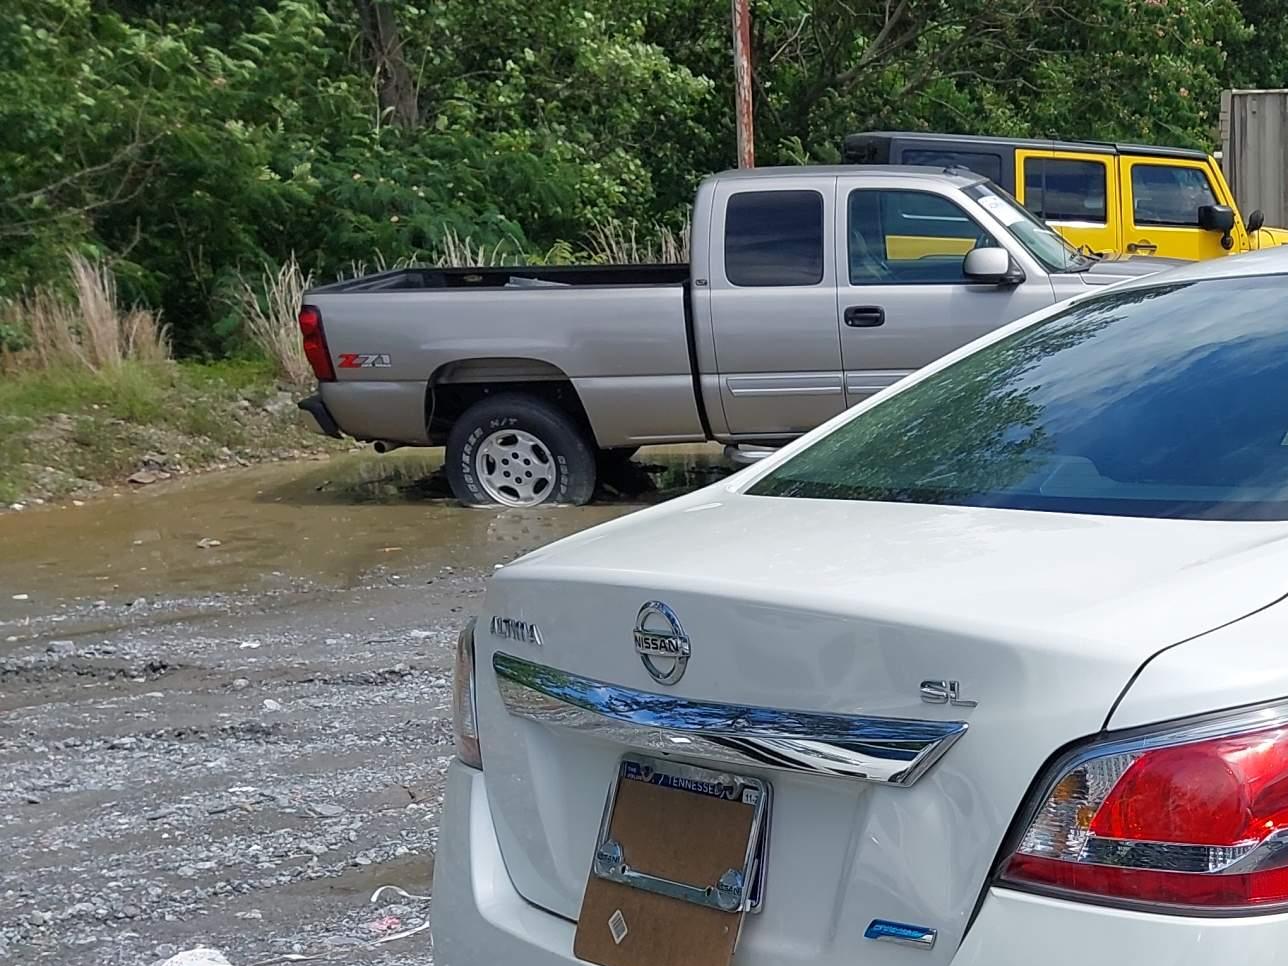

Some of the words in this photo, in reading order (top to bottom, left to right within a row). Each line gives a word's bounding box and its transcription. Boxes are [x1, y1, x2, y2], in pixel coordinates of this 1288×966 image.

[337, 353, 392, 368] Z71
[634, 633, 680, 652] NISSAN
[920, 679, 979, 708] SL
